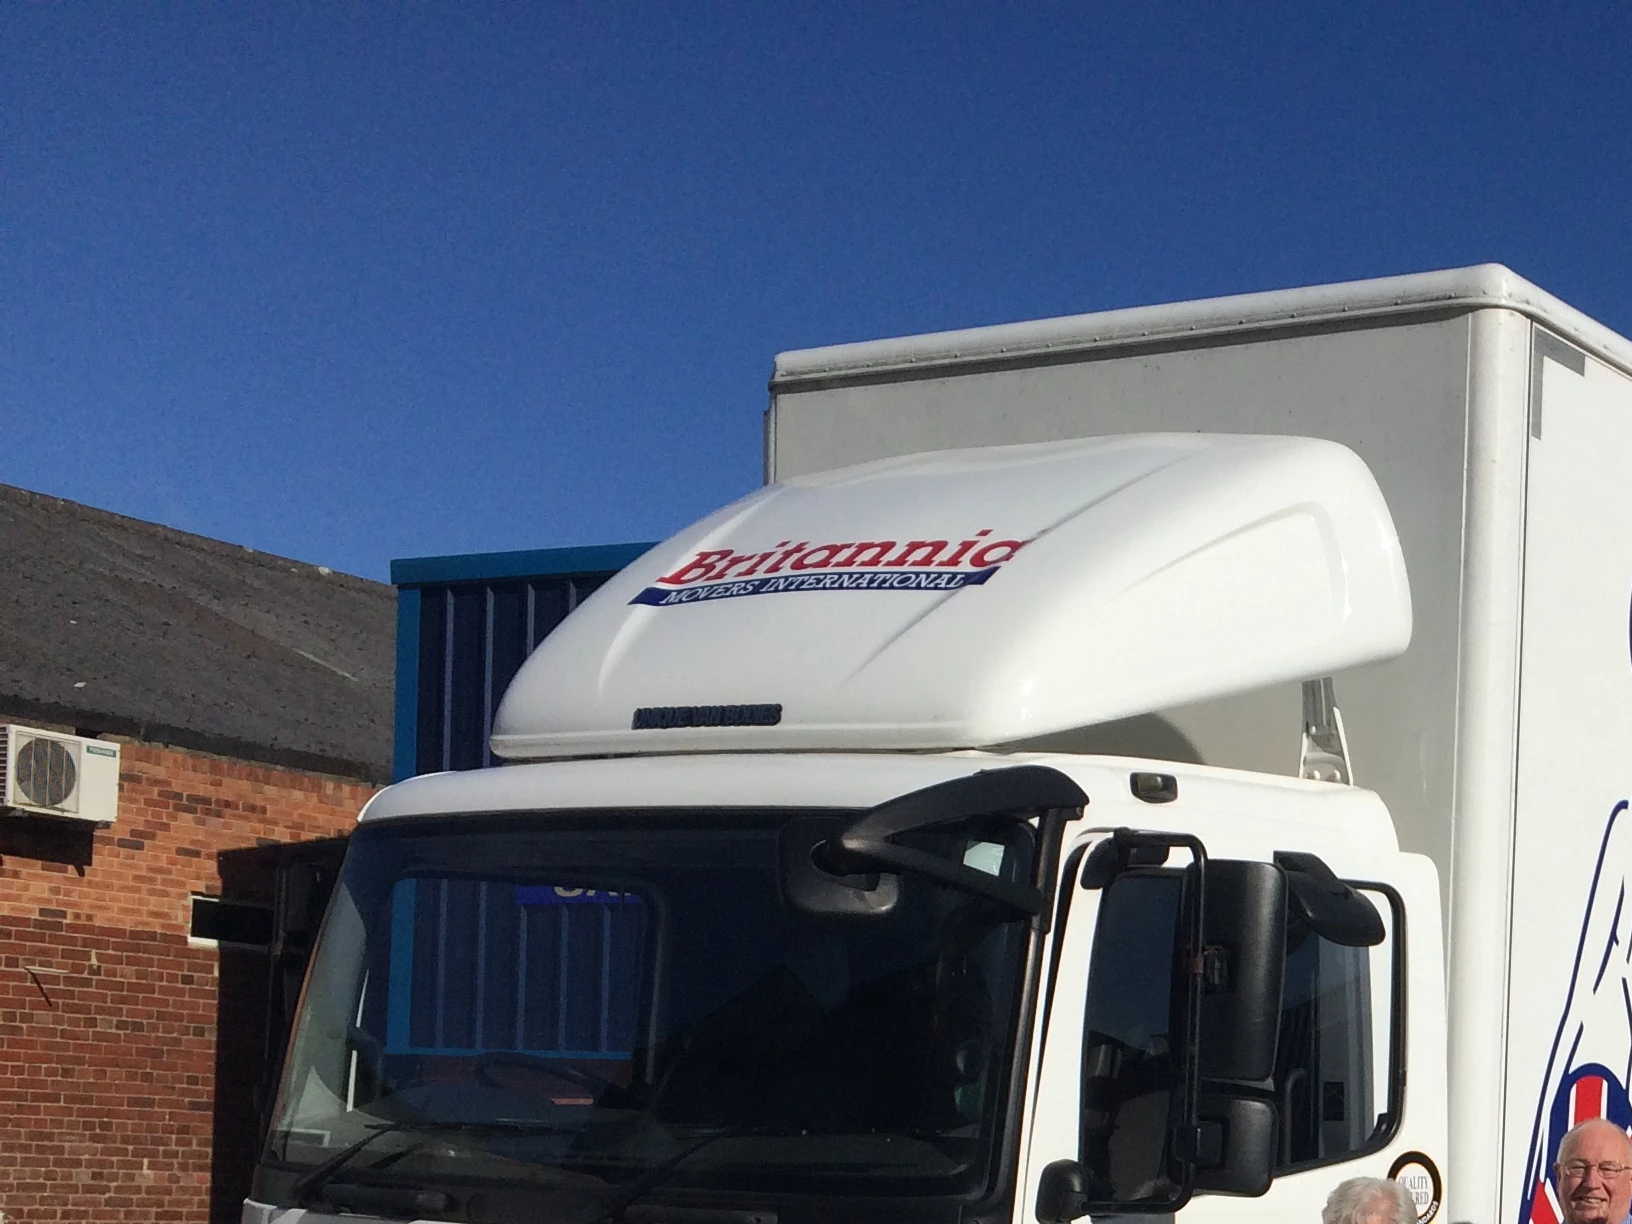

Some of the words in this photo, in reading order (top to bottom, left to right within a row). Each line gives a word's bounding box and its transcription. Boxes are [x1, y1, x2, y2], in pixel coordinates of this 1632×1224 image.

[656, 529, 1031, 585] Britannia
[658, 580, 759, 605] MOVERS
[760, 571, 967, 592] INTERNATIONAL
